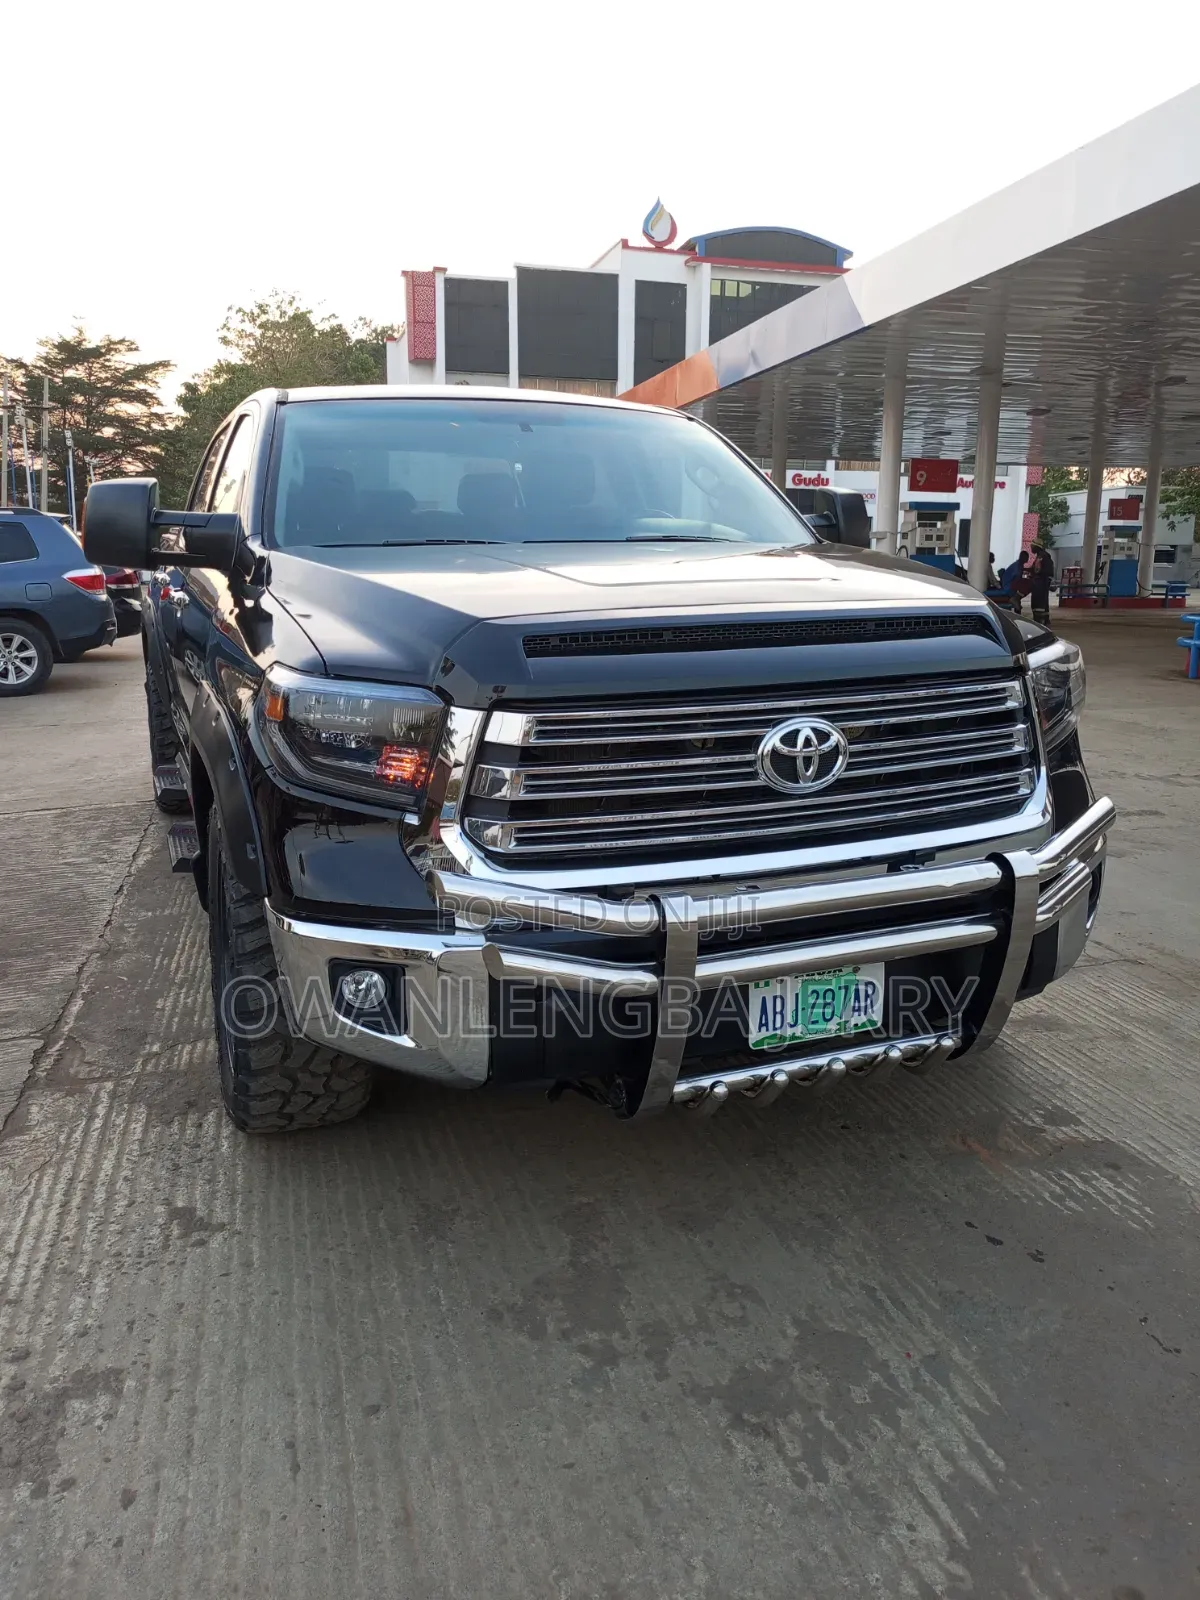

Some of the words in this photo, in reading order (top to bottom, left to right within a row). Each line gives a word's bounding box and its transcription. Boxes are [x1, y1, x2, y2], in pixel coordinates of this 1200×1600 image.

[791, 473, 830, 487] Gudu
[916, 470, 927, 486] 9
[1112, 506, 1123, 517] 15
